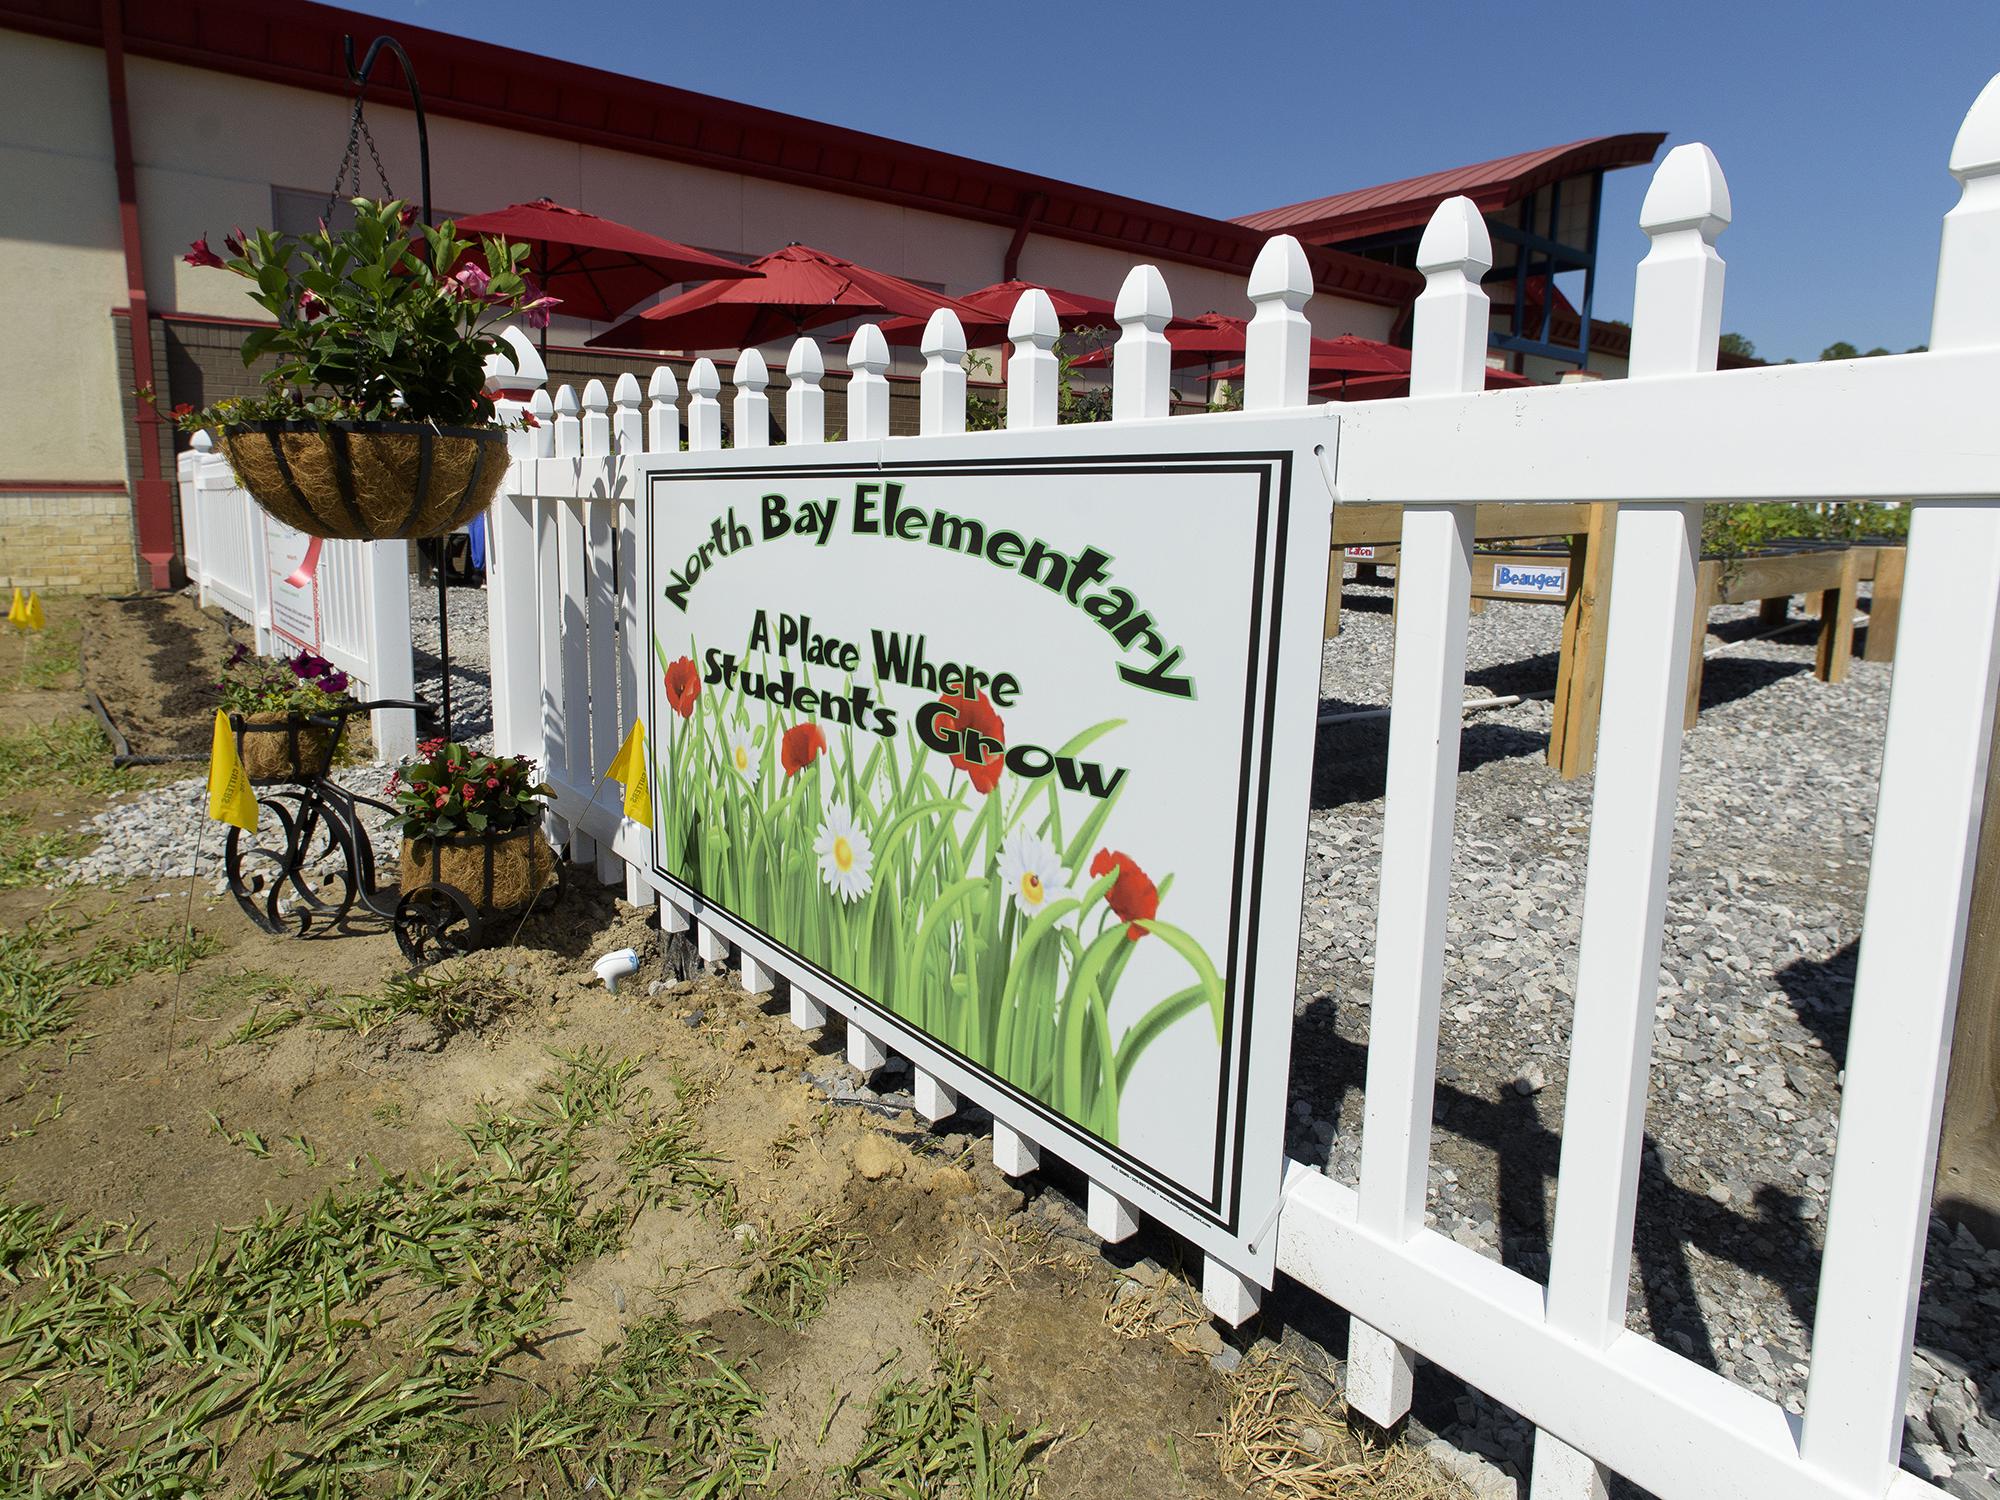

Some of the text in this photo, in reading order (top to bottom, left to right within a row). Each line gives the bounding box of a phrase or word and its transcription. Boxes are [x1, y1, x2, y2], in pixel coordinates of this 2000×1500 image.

[663, 481, 1199, 701] North Bay Elementary
[1501, 567, 1561, 590] Beaugez
[749, 608, 1022, 709] A Place Where
[702, 647, 1132, 801] Students Grow
